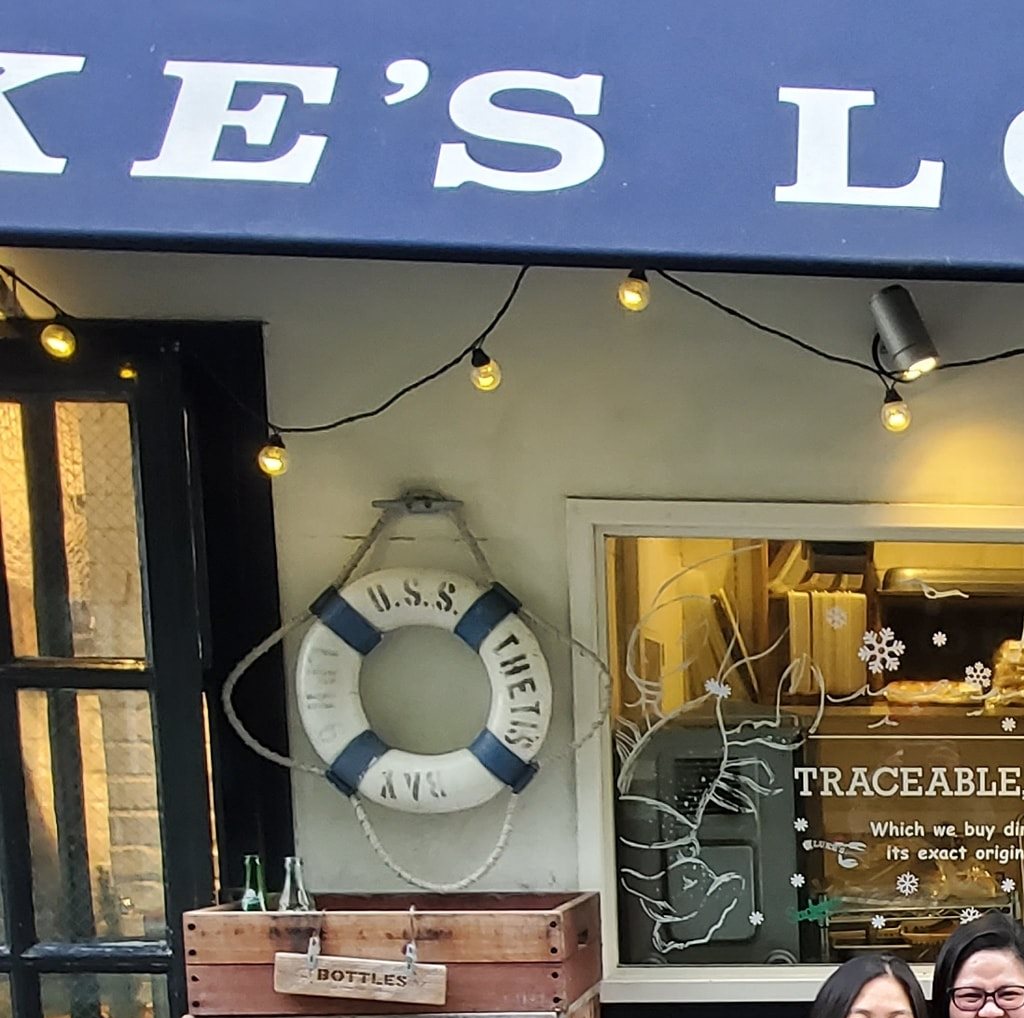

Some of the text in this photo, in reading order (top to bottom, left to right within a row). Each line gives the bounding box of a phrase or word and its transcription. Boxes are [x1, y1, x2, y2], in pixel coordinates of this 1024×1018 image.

[366, 577, 459, 615] U.S.S.
[493, 634, 542, 750] THETIS
[870, 821, 925, 837] Which
[933, 826, 956, 837] we
[964, 821, 996, 841] buy
[917, 847, 967, 861] exact
[975, 845, 1024, 864] origin
[316, 968, 408, 988] BOTTLES
